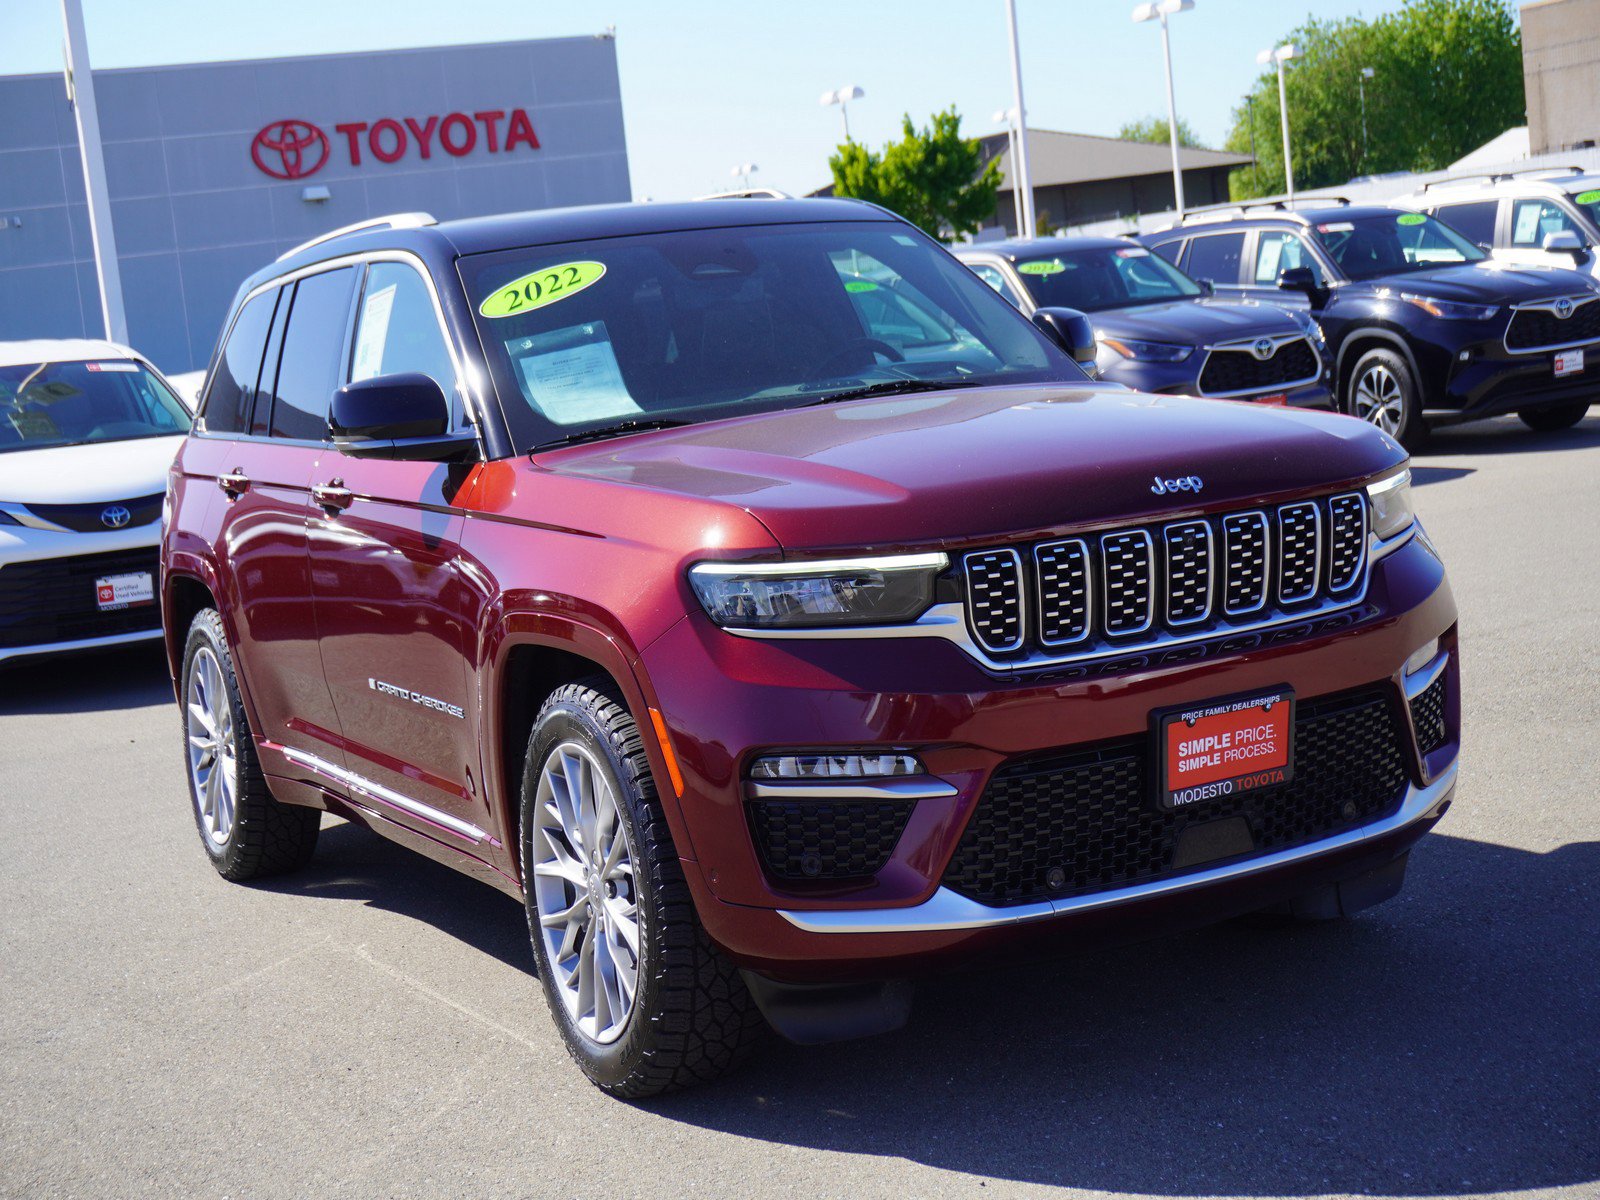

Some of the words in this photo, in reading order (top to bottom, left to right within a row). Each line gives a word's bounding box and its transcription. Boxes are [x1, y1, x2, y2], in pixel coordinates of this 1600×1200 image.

[335, 108, 541, 166] TOYOTA
[504, 267, 582, 312] 2022
[1151, 476, 1204, 495] Jeep
[377, 681, 410, 700] GRAND
[411, 692, 465, 719] CHEROKEE
[1181, 710, 1204, 721] PRICE
[1205, 705, 1231, 717] FAMILY
[1232, 695, 1280, 710] DEALERSHIPS
[1178, 732, 1231, 757] SIMPLE
[1235, 724, 1277, 745] PRICE.
[1178, 752, 1221, 773] SIMPLE
[1224, 741, 1277, 763] PROCESS.
[1174, 781, 1233, 806] MODESTO
[1236, 770, 1285, 791] TOYOTA
